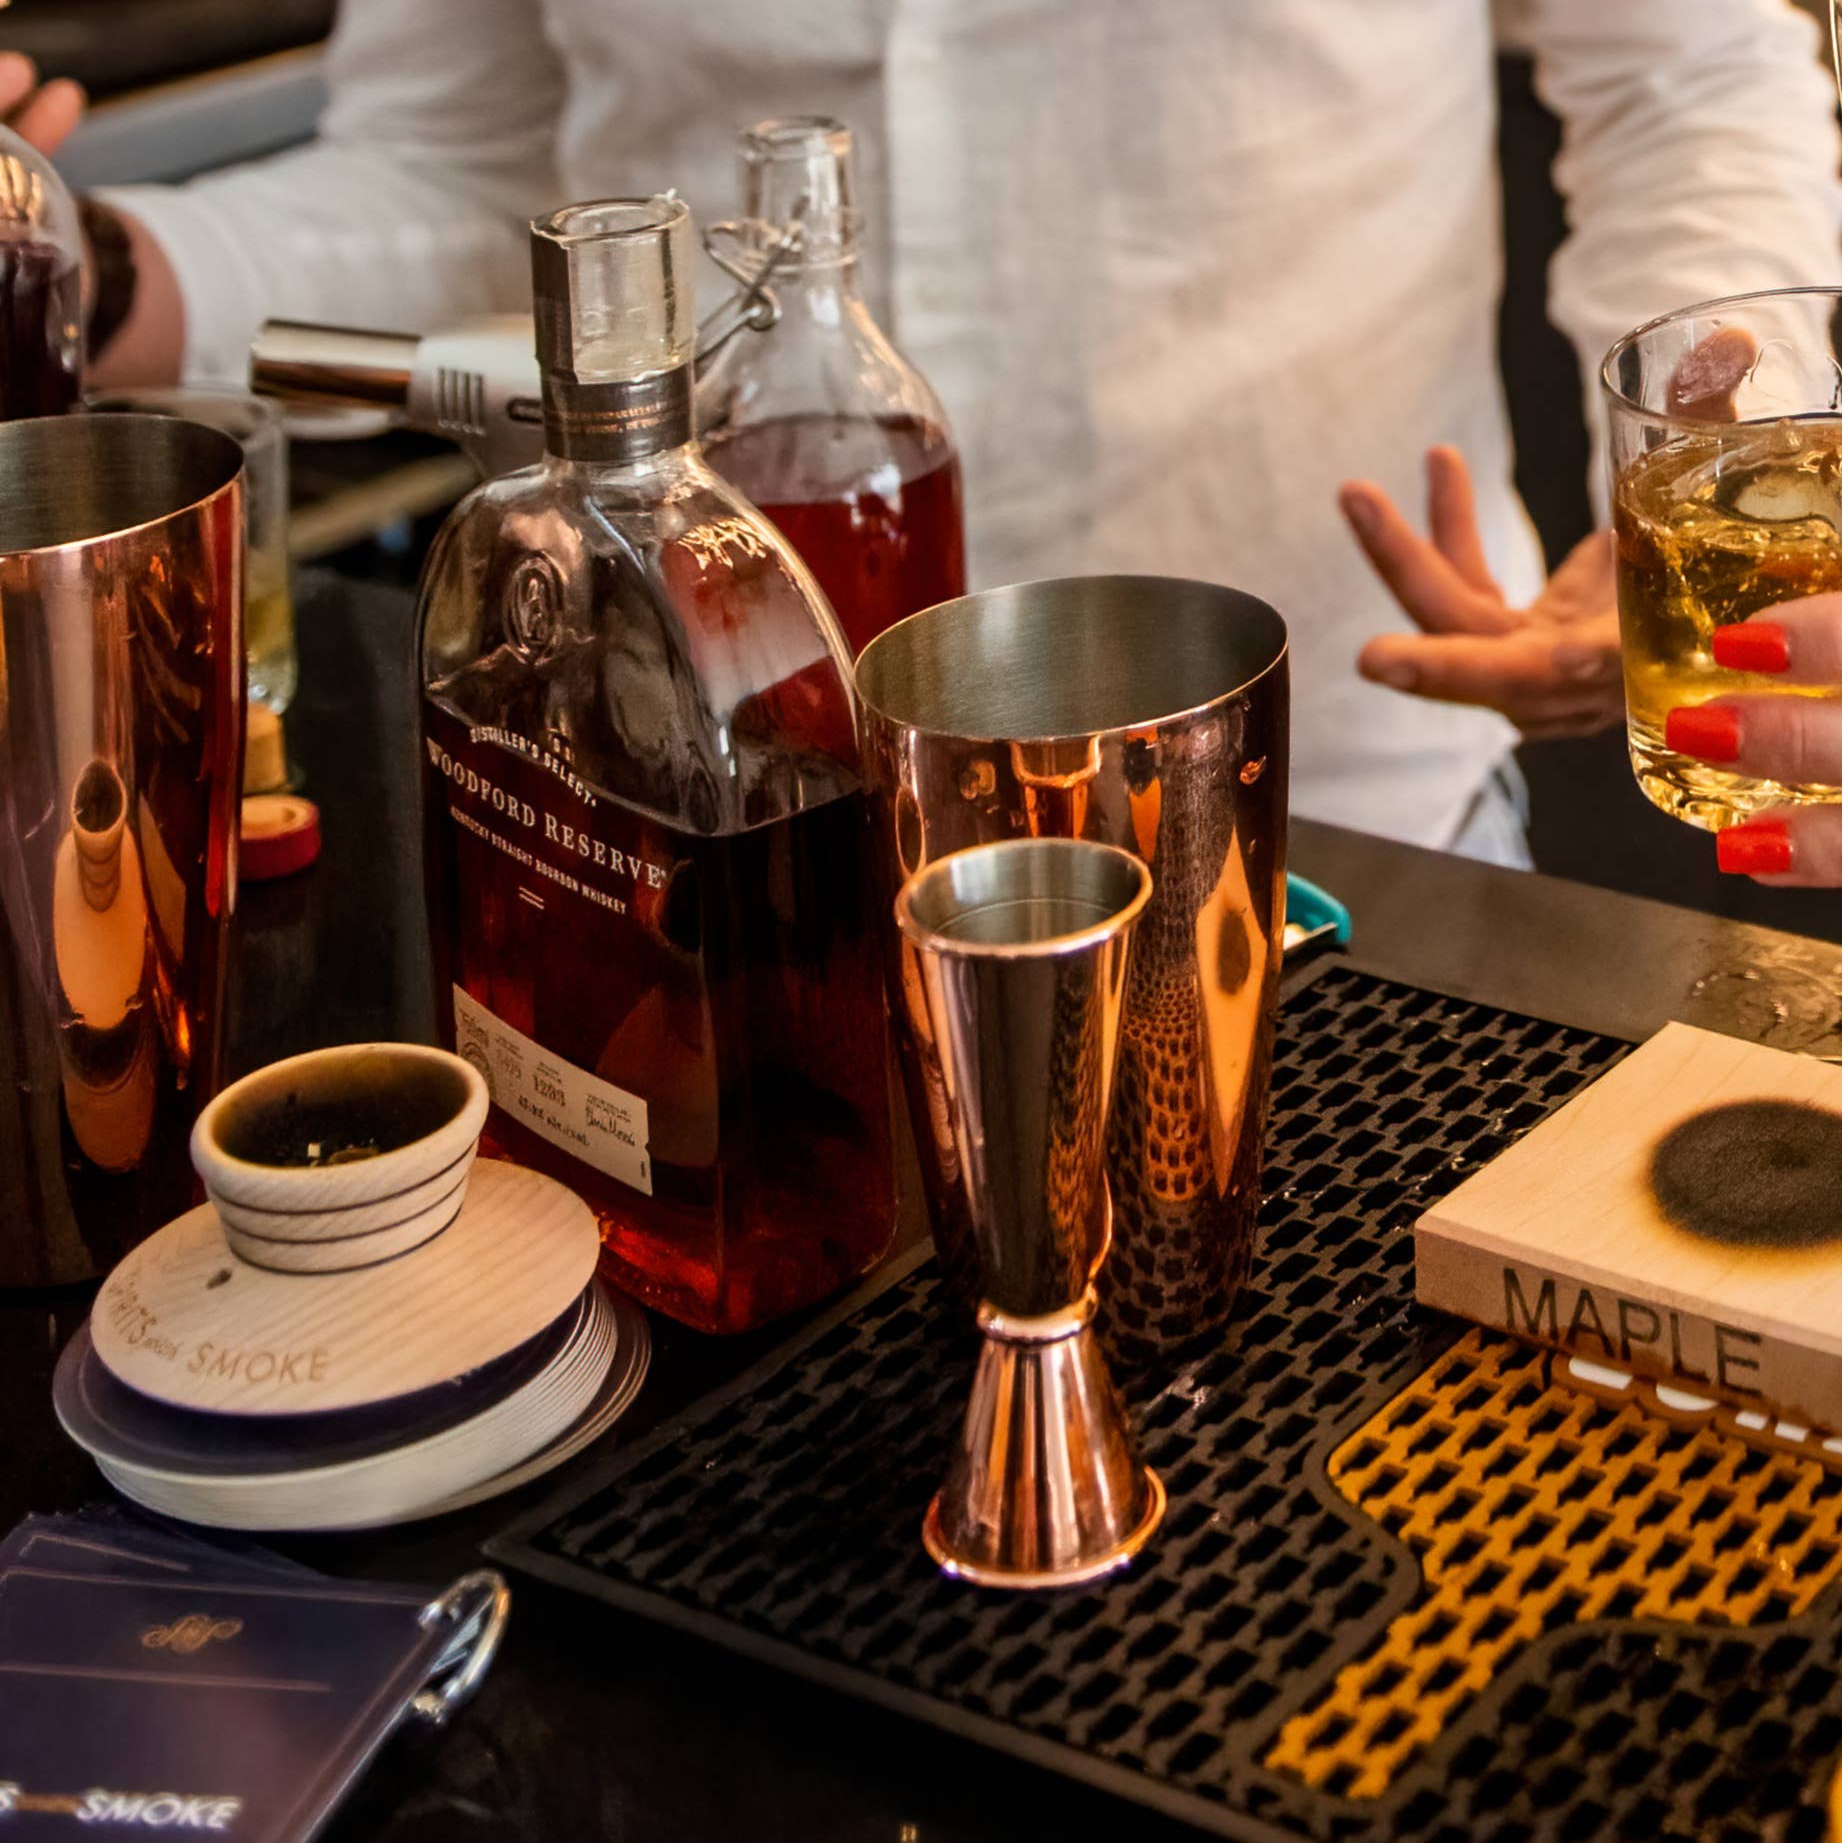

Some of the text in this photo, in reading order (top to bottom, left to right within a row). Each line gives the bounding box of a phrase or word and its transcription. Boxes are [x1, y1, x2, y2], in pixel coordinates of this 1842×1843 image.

[426, 736, 663, 888] WOODFORD RESERVE
[491, 831, 533, 867] STRAIGHT
[535, 859, 579, 893] BOURBON
[581, 882, 627, 916] WHISKEY
[187, 1341, 329, 1384] SMOKE
[1502, 1267, 1762, 1395] MAPLE
[75, 1786, 242, 1829] SMOKE
